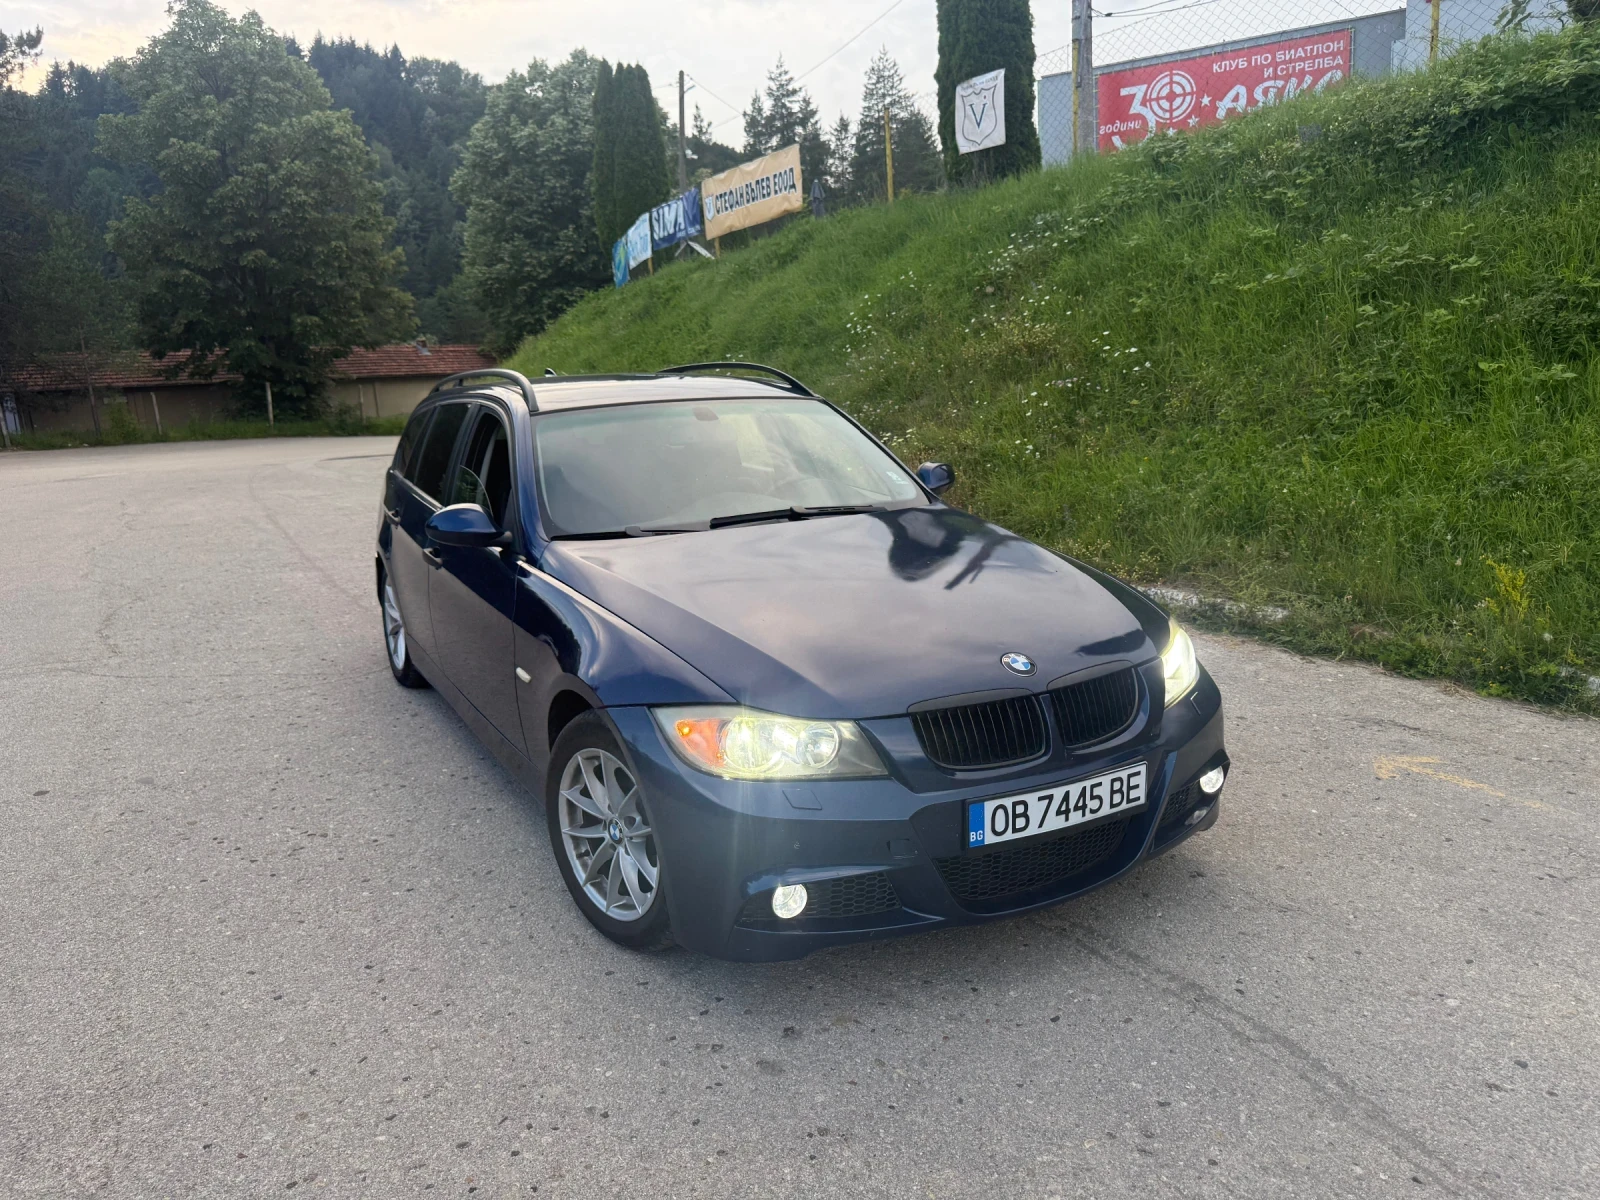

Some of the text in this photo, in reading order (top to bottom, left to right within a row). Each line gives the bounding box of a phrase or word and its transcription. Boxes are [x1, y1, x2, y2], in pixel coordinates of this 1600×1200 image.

[1212, 40, 1344, 73] КЛУБ ПО БИАТЛОН
[1263, 55, 1344, 79] И СТРЕЛБА
[1099, 120, 1142, 135] години
[715, 186, 744, 214] СТЕФАН
[773, 167, 797, 195] ЕООД
[990, 771, 1141, 836] OB 7445 BE
[969, 830, 984, 843] BG
